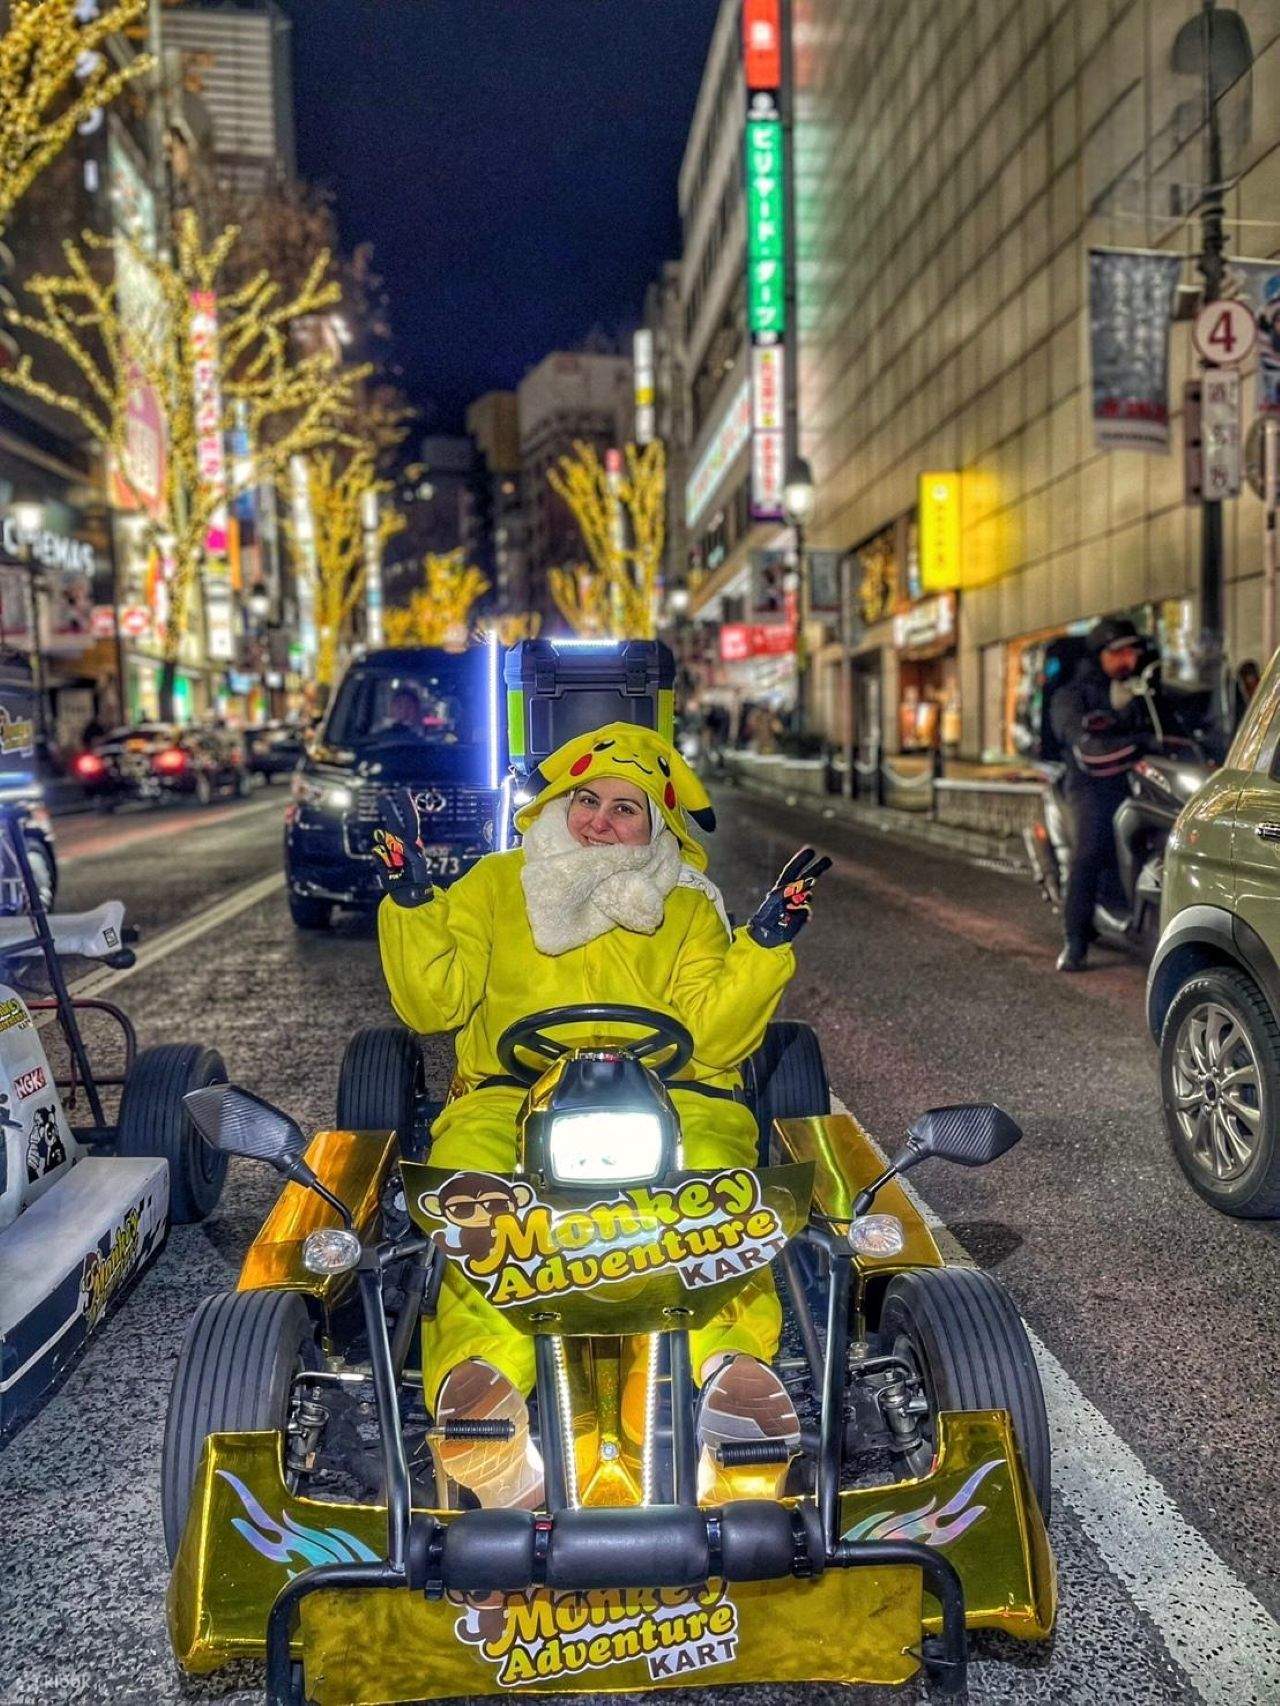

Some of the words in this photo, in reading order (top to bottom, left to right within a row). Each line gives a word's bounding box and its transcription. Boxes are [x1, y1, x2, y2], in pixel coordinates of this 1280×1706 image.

[1208, 310, 1236, 353] 4
[15, 1068, 43, 1099] NGK
[466, 1170, 760, 1277] Monkey
[491, 1209, 778, 1304] Adventure
[677, 1233, 786, 1290] KART
[500, 1602, 733, 1685] Adventure
[651, 1637, 737, 1678] KART
